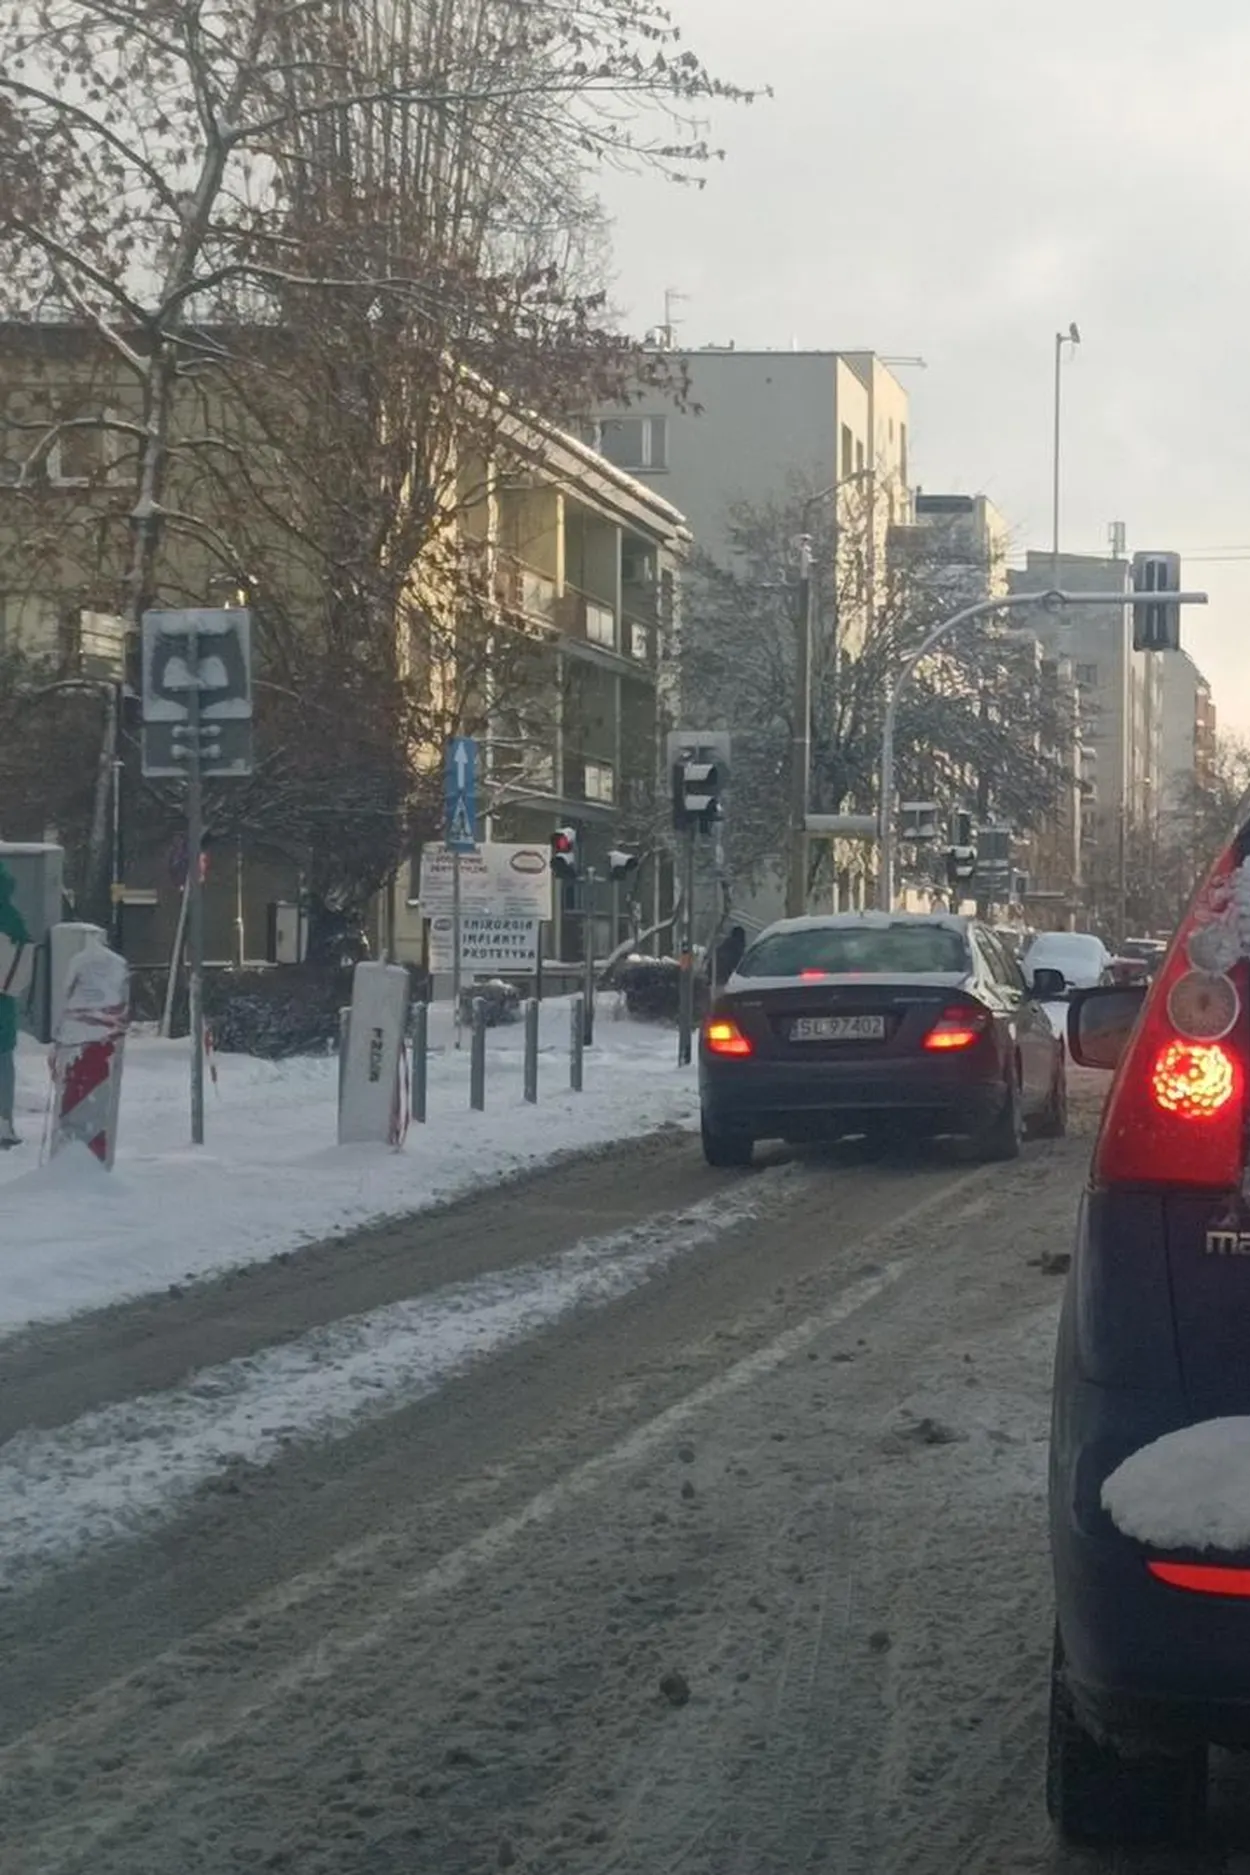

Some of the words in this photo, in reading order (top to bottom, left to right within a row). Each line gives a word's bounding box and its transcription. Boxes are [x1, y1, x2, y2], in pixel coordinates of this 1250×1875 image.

[463, 920, 533, 931] CHIRURGIA
[462, 934, 526, 945] IMPLANTY
[462, 949, 536, 960] PROTETYKA
